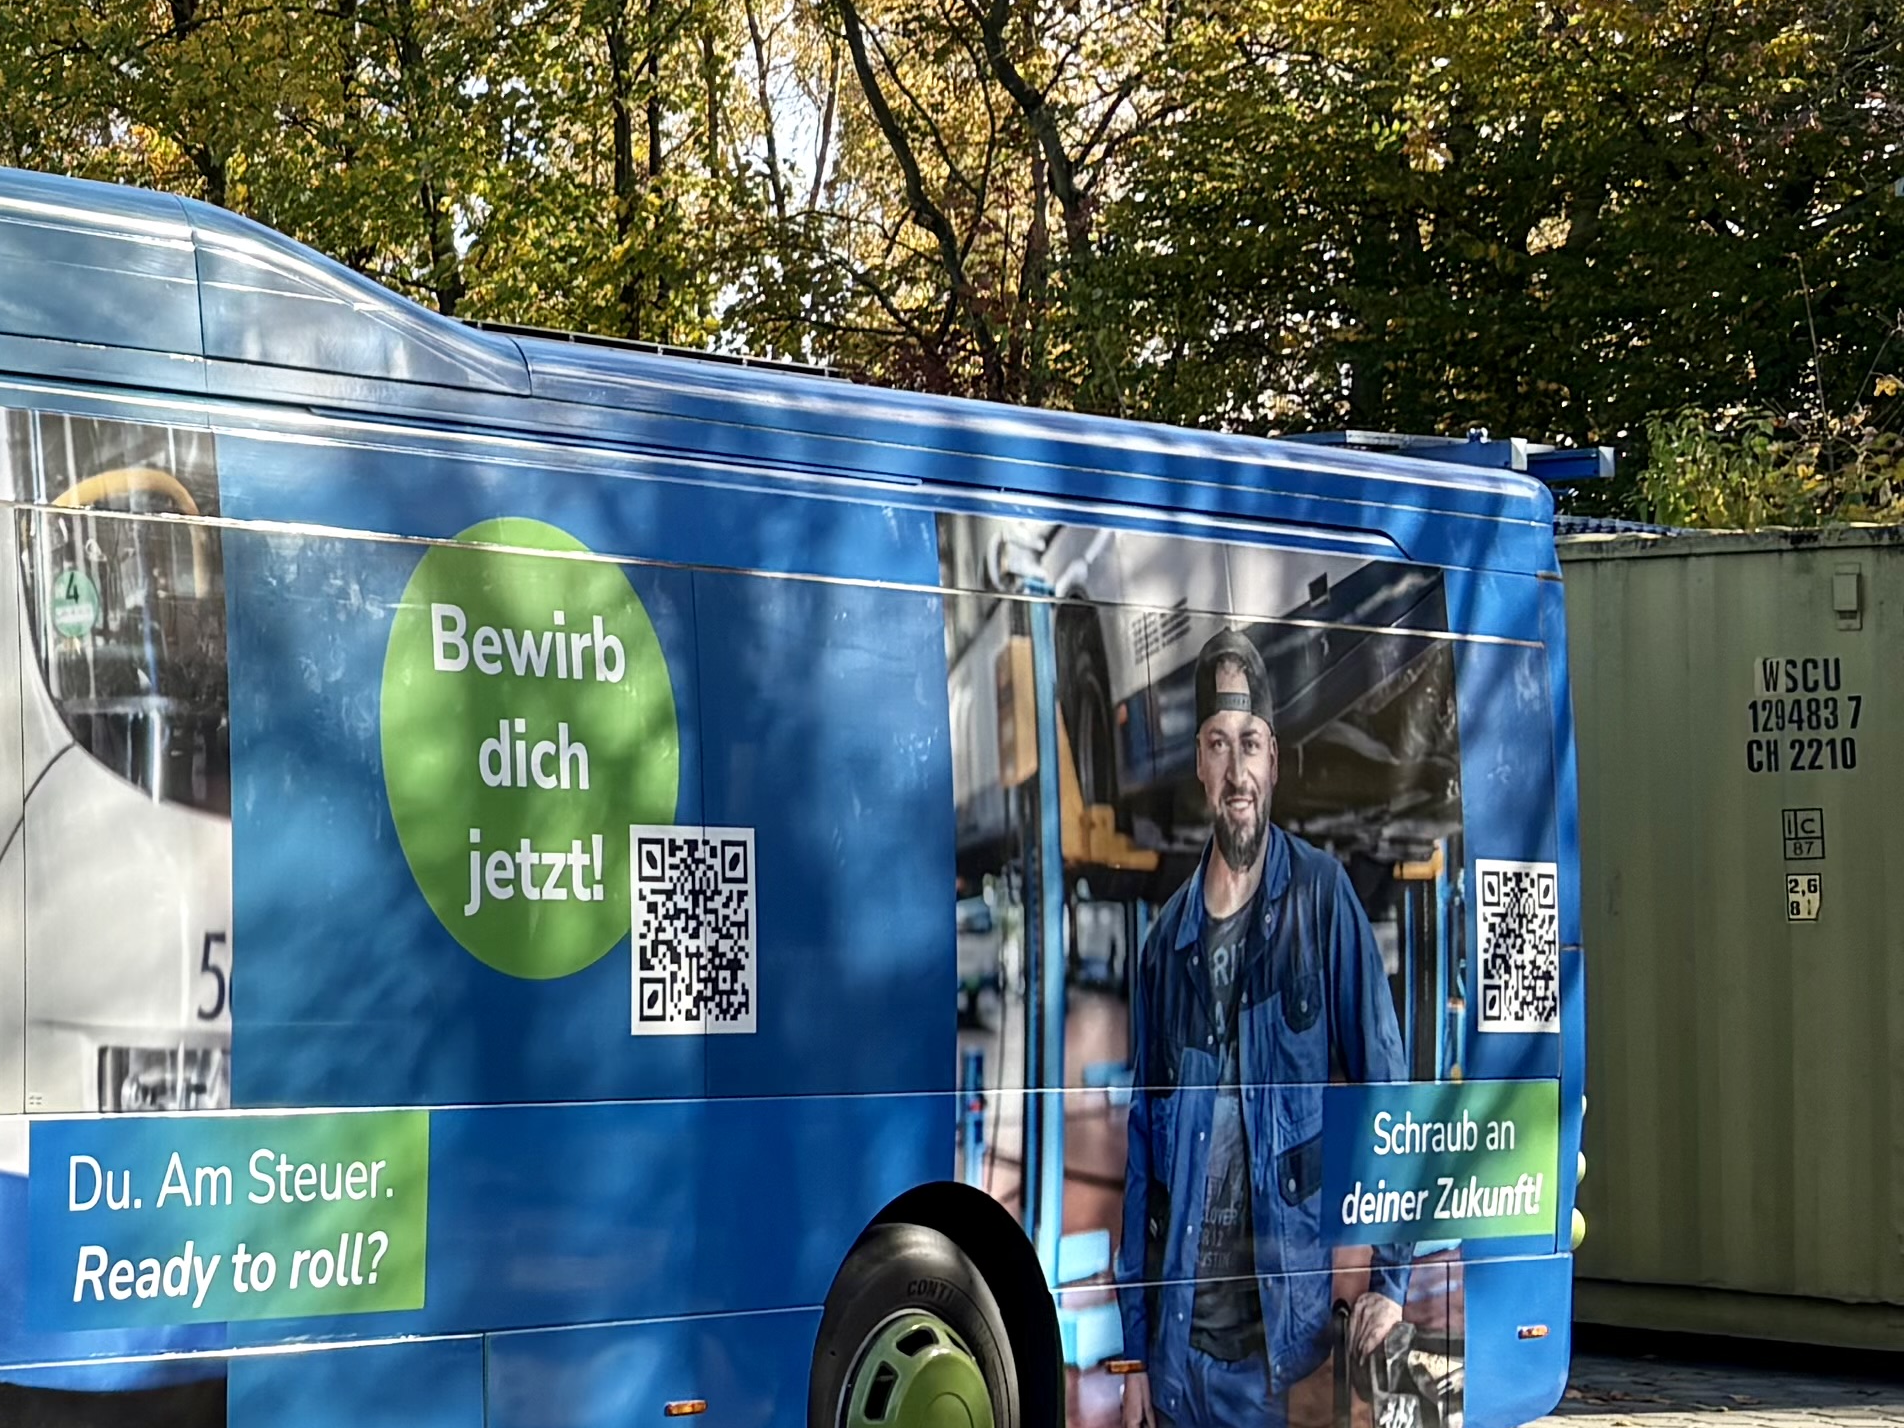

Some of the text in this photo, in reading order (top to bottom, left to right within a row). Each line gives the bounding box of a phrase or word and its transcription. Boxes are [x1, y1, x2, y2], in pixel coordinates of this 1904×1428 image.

[431, 603, 626, 684] Bewirb
[1763, 657, 1841, 693] WSCU
[1748, 695, 1862, 733] 129483 7
[479, 717, 589, 791] dich
[1747, 737, 1857, 772] CH 2210
[465, 829, 605, 917] jetzt!
[197, 931, 233, 1021] 5
[1373, 1110, 1515, 1155] Schraub an
[68, 1149, 394, 1212] Du. Am Steuer.
[1341, 1171, 1542, 1224] deiner Zukunft!
[73, 1231, 388, 1308] Ready to roll?
